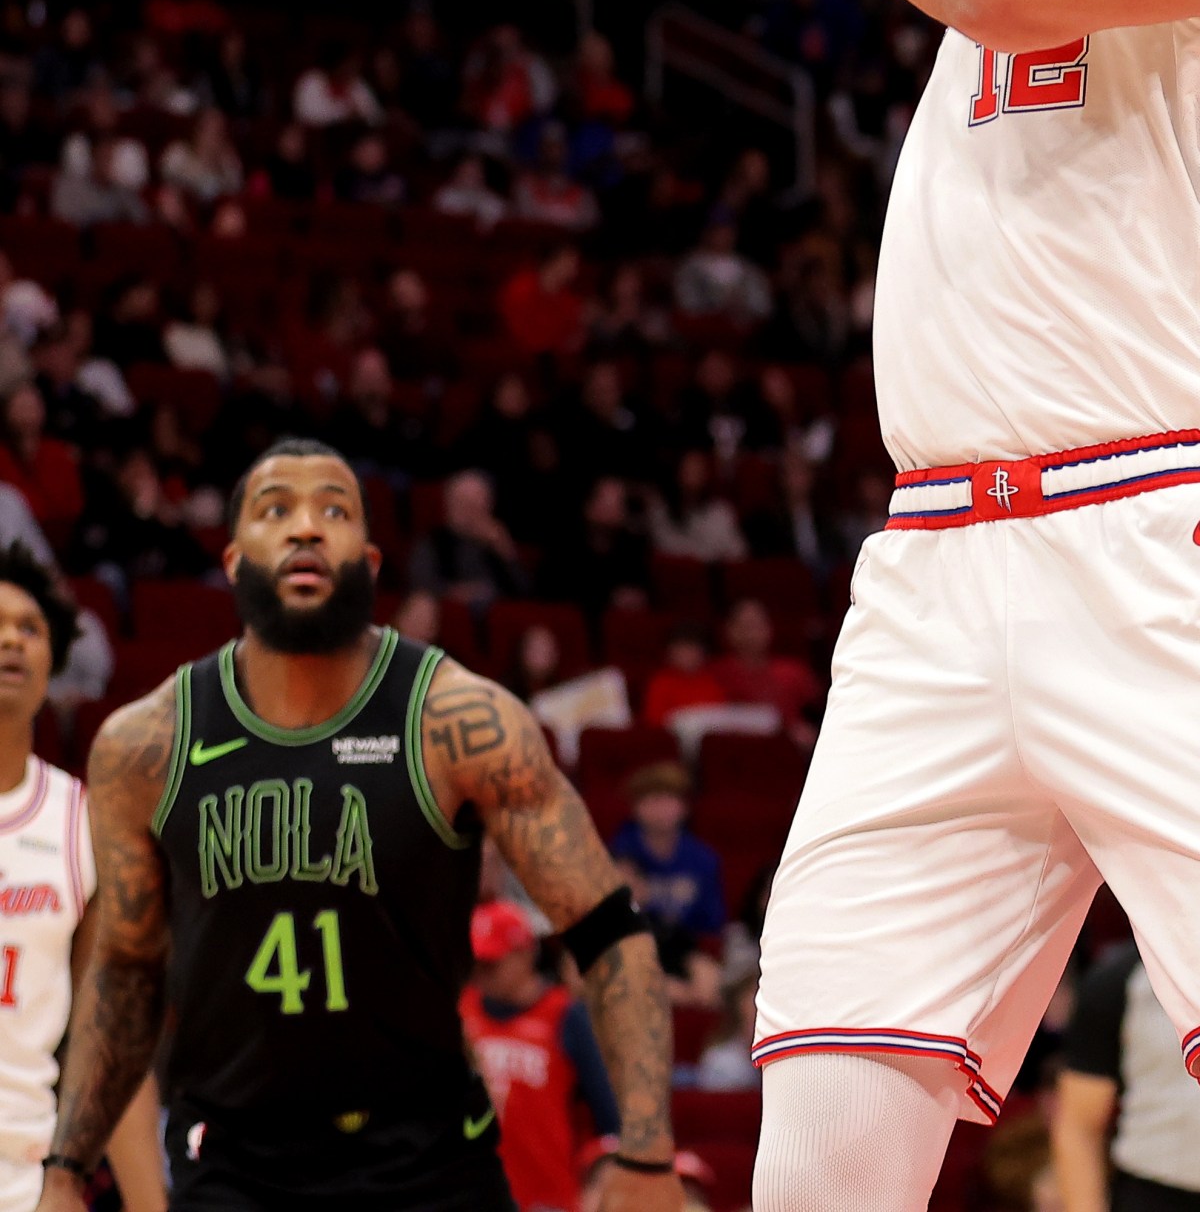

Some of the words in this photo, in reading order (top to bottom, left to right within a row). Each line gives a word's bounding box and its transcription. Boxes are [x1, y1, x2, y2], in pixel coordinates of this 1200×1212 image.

[968, 34, 1090, 128] 12
[198, 777, 380, 899] NOLA
[244, 909, 349, 1015] 41
